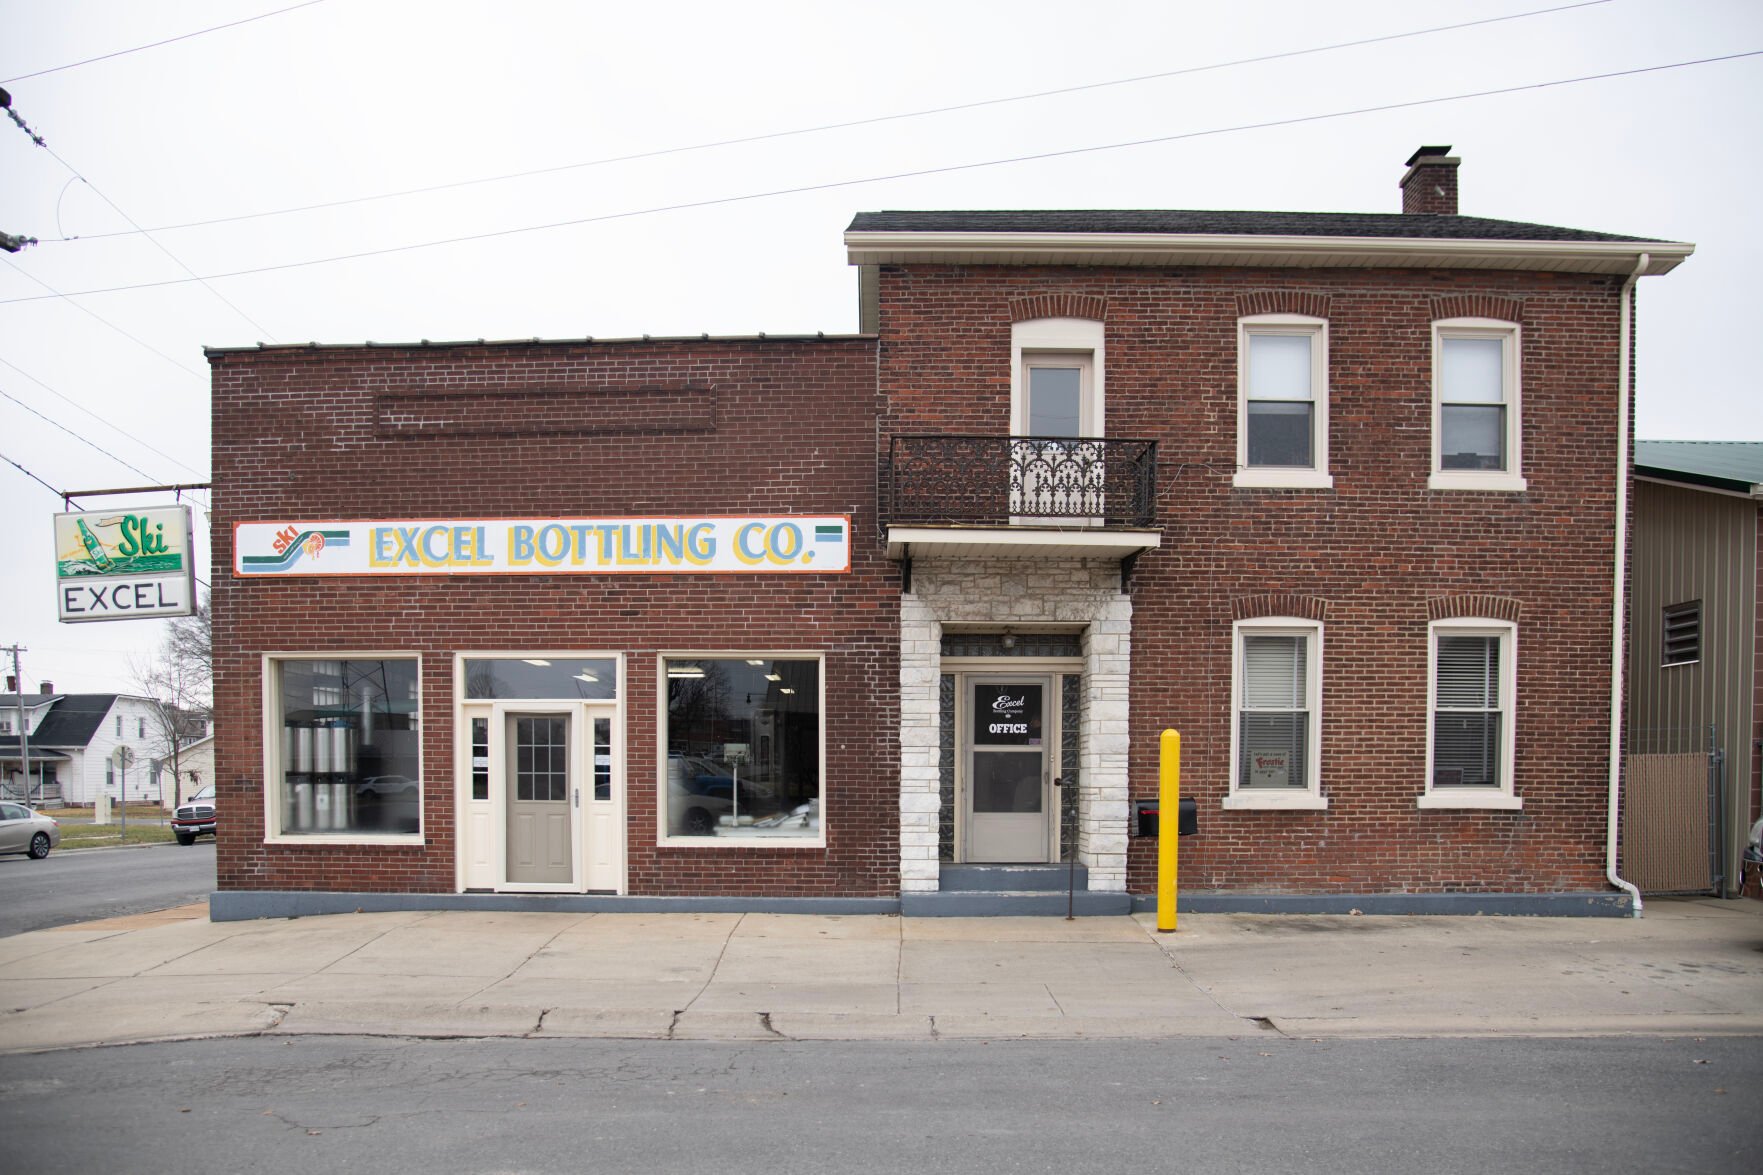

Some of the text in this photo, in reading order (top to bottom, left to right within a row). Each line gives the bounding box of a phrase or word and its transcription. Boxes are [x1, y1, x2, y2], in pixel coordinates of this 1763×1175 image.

[118, 513, 169, 556] Ski
[369, 522, 816, 568] EXCEL BOTTLING CO.
[64, 582, 178, 613] EXCEL
[992, 695, 1025, 710] Excel
[989, 723, 1028, 734] OFFICE
